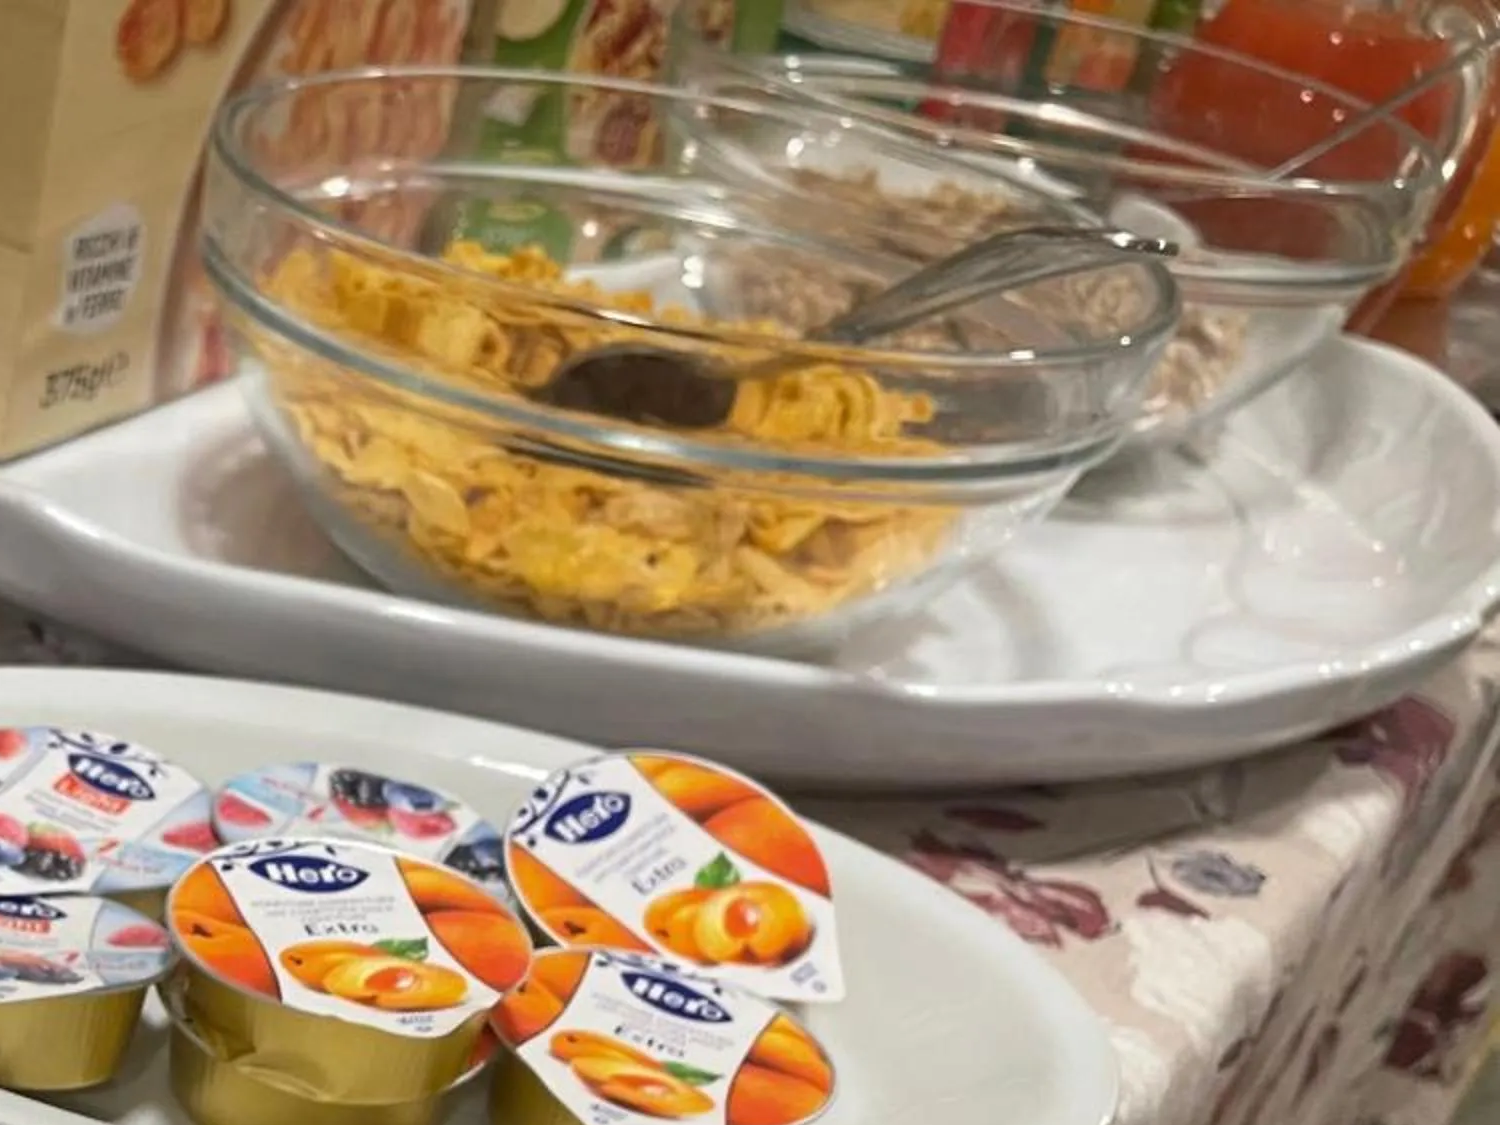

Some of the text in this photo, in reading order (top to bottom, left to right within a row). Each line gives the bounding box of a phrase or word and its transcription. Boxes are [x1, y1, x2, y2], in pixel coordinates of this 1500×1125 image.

[74, 757, 151, 799] Hero
[552, 795, 625, 843] Hero
[265, 861, 359, 885] Hero
[303, 922, 380, 936] Extra
[631, 976, 724, 1021] Hero
